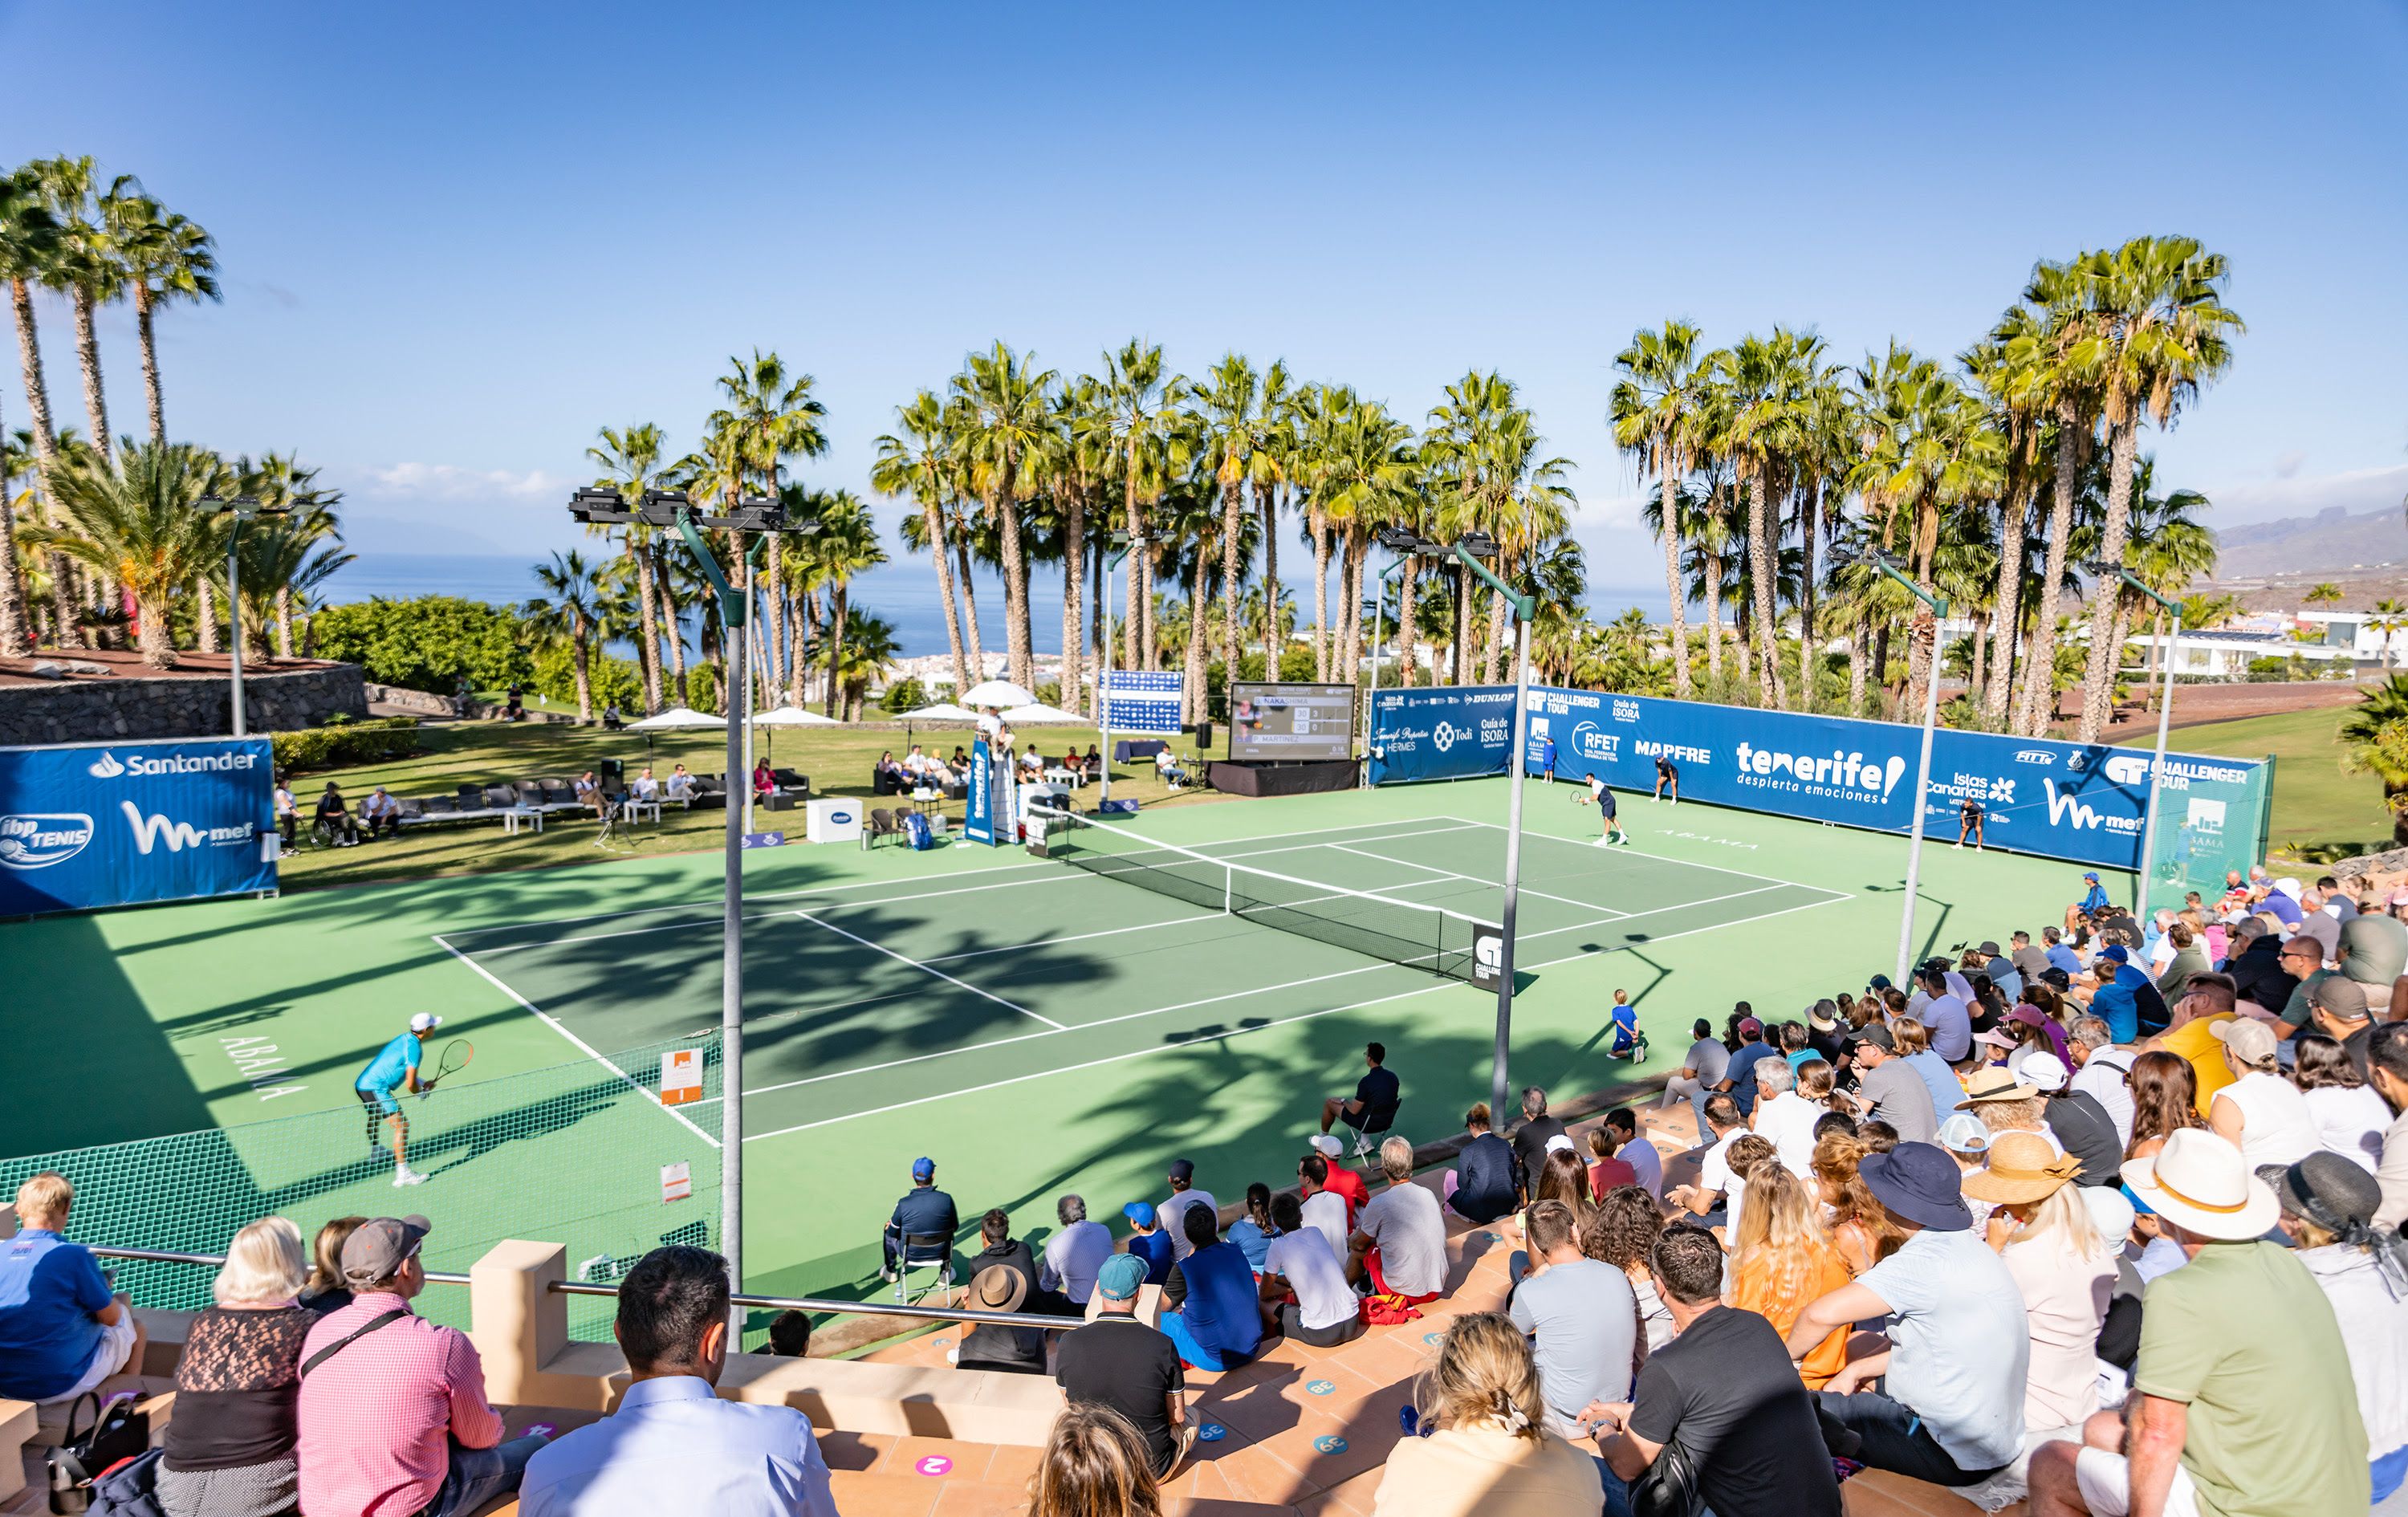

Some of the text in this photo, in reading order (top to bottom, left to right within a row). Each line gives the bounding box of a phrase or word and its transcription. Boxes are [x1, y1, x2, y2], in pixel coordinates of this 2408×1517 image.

[1472, 693, 1515, 703] DUNLOP
[1547, 692, 1601, 709] CHALLENGER
[1613, 698, 1639, 710] Guía de
[1547, 702, 1569, 715] TOUR
[1612, 707, 1640, 719] ISORA
[1481, 717, 1508, 729] Guía de
[1372, 727, 1401, 742] Tenerife
[1454, 727, 1473, 740] Todi
[1480, 728, 1509, 743] ISORA
[1387, 741, 1416, 752] HERMES
[1584, 732, 1621, 752] RFET
[1634, 740, 1711, 765] MAPFRE
[2015, 750, 2048, 763] FITT
[127, 751, 258, 777] Santander
[1735, 742, 1906, 805] tenerife!
[1953, 771, 1988, 789] Islas
[1736, 771, 1879, 804] despierta emociones
[1926, 779, 1987, 800] Canarias
[2105, 815, 2145, 831] mef
[31, 829, 88, 848] TENIS
[209, 822, 254, 841] mef
[1475, 962, 1501, 976] CHALLENG
[1475, 970, 1490, 980] TOUR
[218, 1035, 310, 1102] ABAMA
[1310, 1380, 1335, 1394] 38
[1199, 1425, 1223, 1439] 39
[1319, 1437, 1344, 1452] 39
[923, 1457, 947, 1473] 2
